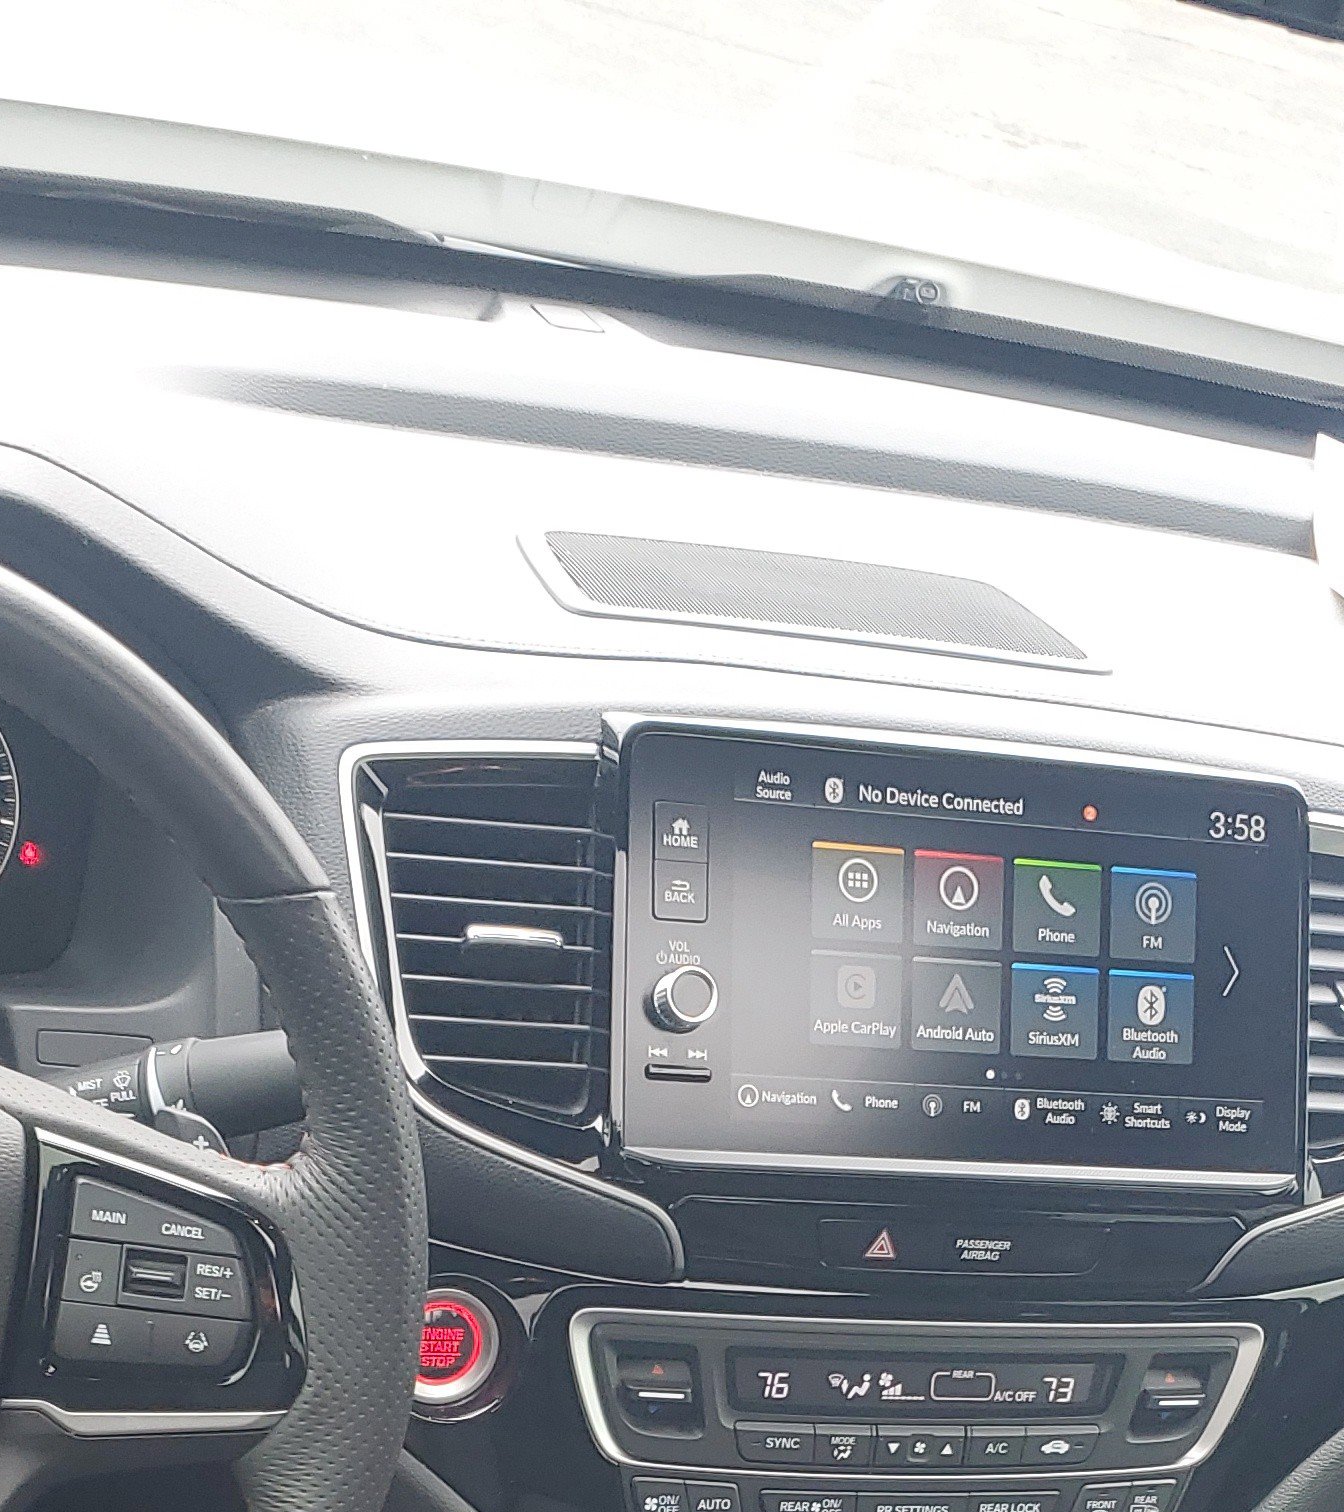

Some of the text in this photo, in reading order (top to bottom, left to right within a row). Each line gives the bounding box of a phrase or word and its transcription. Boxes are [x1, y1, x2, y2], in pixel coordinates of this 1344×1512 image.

[758, 769, 791, 787] Audio
[755, 786, 792, 802] Source
[858, 784, 1024, 817] No Device Connected
[1208, 811, 1266, 843] 3:58
[663, 833, 699, 849] HOME
[664, 890, 695, 905] BACK
[832, 913, 882, 932] All Apps
[926, 920, 990, 939] Navigation
[1037, 928, 1076, 944] Phone
[1142, 935, 1163, 950] FM
[668, 940, 690, 952] VOL
[668, 953, 701, 966] AUDIO
[813, 1018, 897, 1038] Apple CarPlay
[916, 1025, 995, 1043] Android Auto
[1028, 1031, 1080, 1047] SiriusXM
[1122, 1028, 1179, 1044] Bluetooth
[1132, 1046, 1167, 1060] Audio
[110, 1089, 137, 1102] PULL
[761, 1091, 817, 1107] Navigation
[864, 1095, 899, 1110] Phone
[962, 1101, 982, 1114] FM
[1036, 1098, 1086, 1112] Bluetooth
[1133, 1103, 1162, 1116] Smart
[1045, 1112, 1076, 1126] Audio
[1215, 1107, 1251, 1121] Display
[1124, 1116, 1171, 1130] Shortcuts
[1218, 1120, 1248, 1133] Mode
[90, 1209, 127, 1225] MAIN
[161, 1223, 205, 1240] CANCEL
[955, 1239, 1012, 1251] PASSENGER
[960, 1250, 1000, 1261] AIRBAG
[196, 1263, 234, 1280] RES/+
[420, 1341, 460, 1352] START
[420, 1357, 456, 1368] STOP
[952, 1369, 975, 1379] REAR
[757, 1371, 790, 1400] 76
[1042, 1378, 1075, 1403] 73
[994, 1389, 1037, 1403] A/C OFF
[765, 1437, 801, 1450] SYNC
[831, 1436, 856, 1446] MODE
[985, 1442, 1009, 1455] A/C
[697, 1498, 732, 1511] AUTO
[779, 1501, 809, 1512] REAR
[1086, 1500, 1117, 1510] FRONT
[1134, 1495, 1158, 1505] REAR
